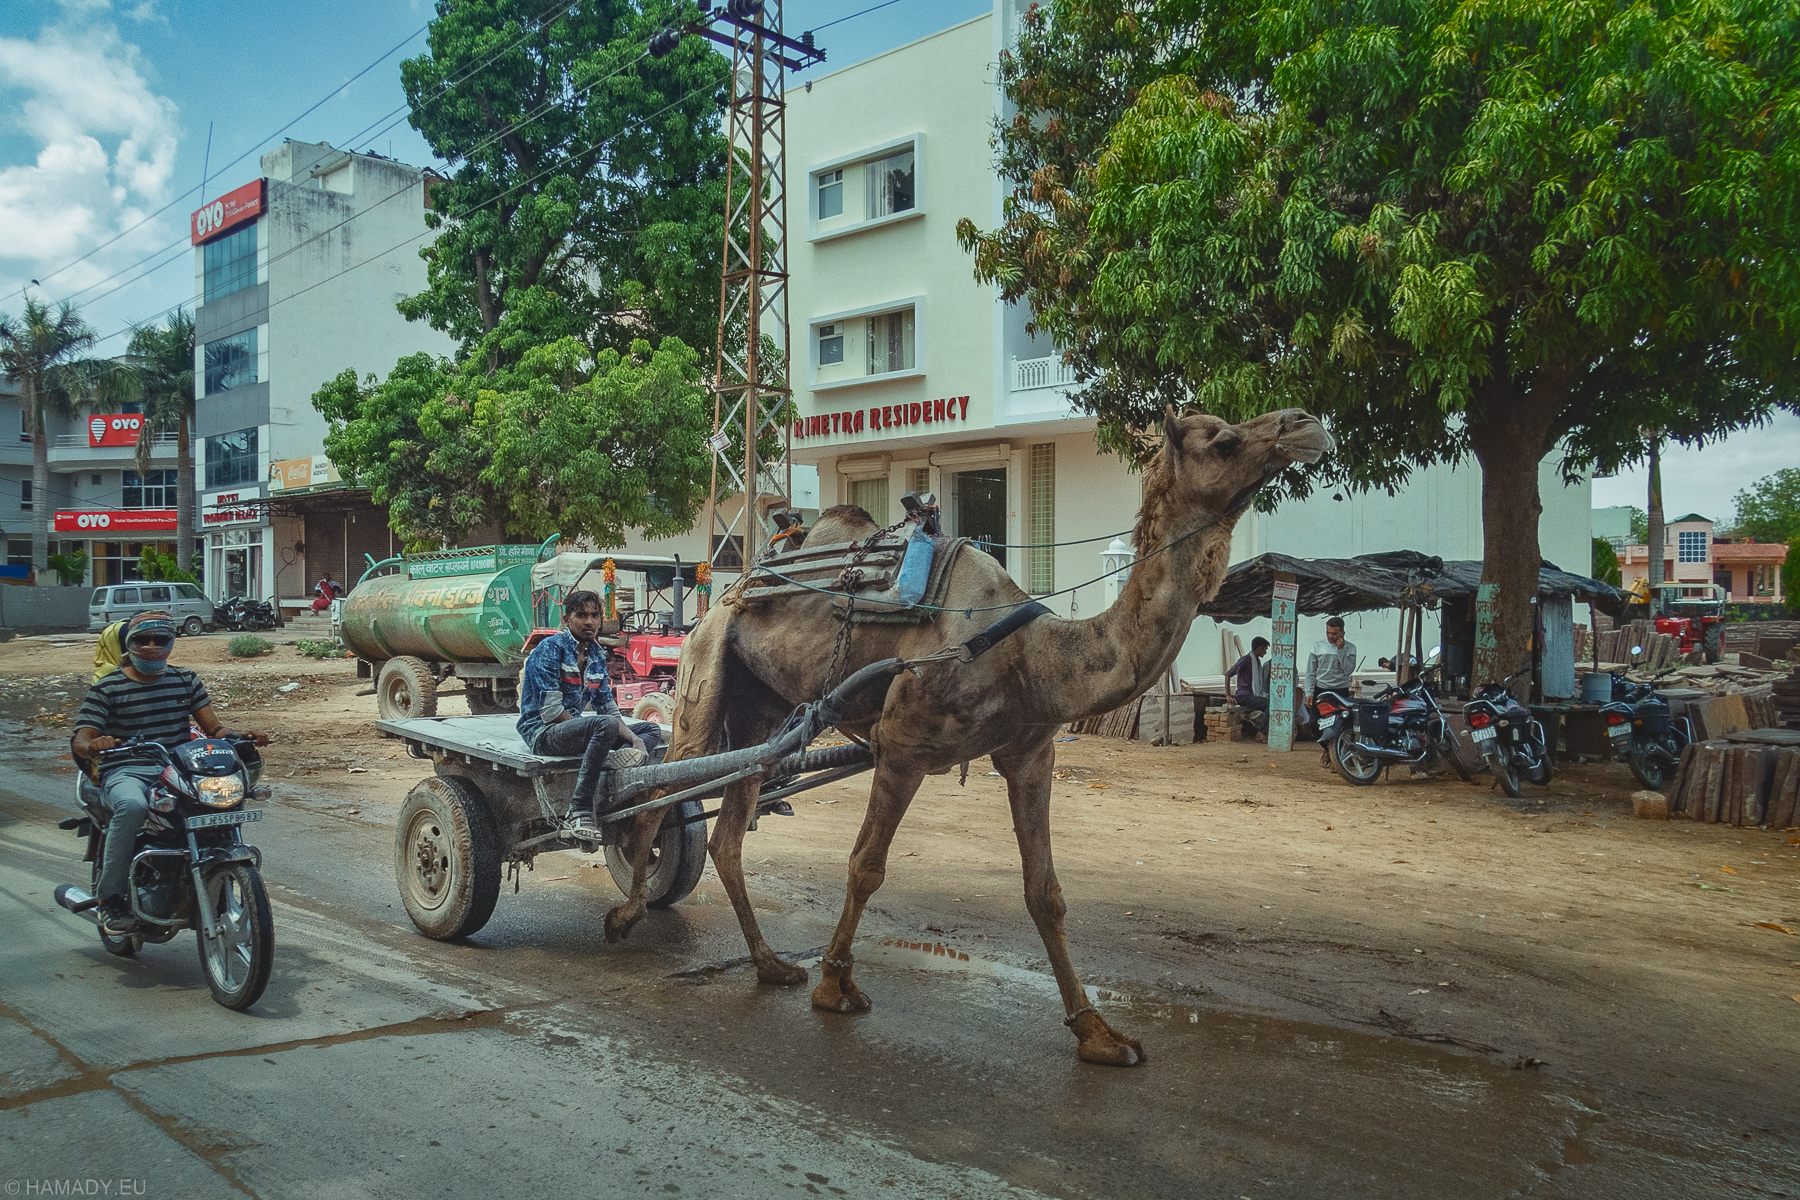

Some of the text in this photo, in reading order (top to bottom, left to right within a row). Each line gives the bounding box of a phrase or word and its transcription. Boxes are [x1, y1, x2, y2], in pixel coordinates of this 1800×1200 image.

[197, 201, 224, 236] OYO
[112, 418, 140, 430] OYO
[793, 396, 970, 439] RINETRA RESIDENCY
[77, 514, 111, 528] OYO
